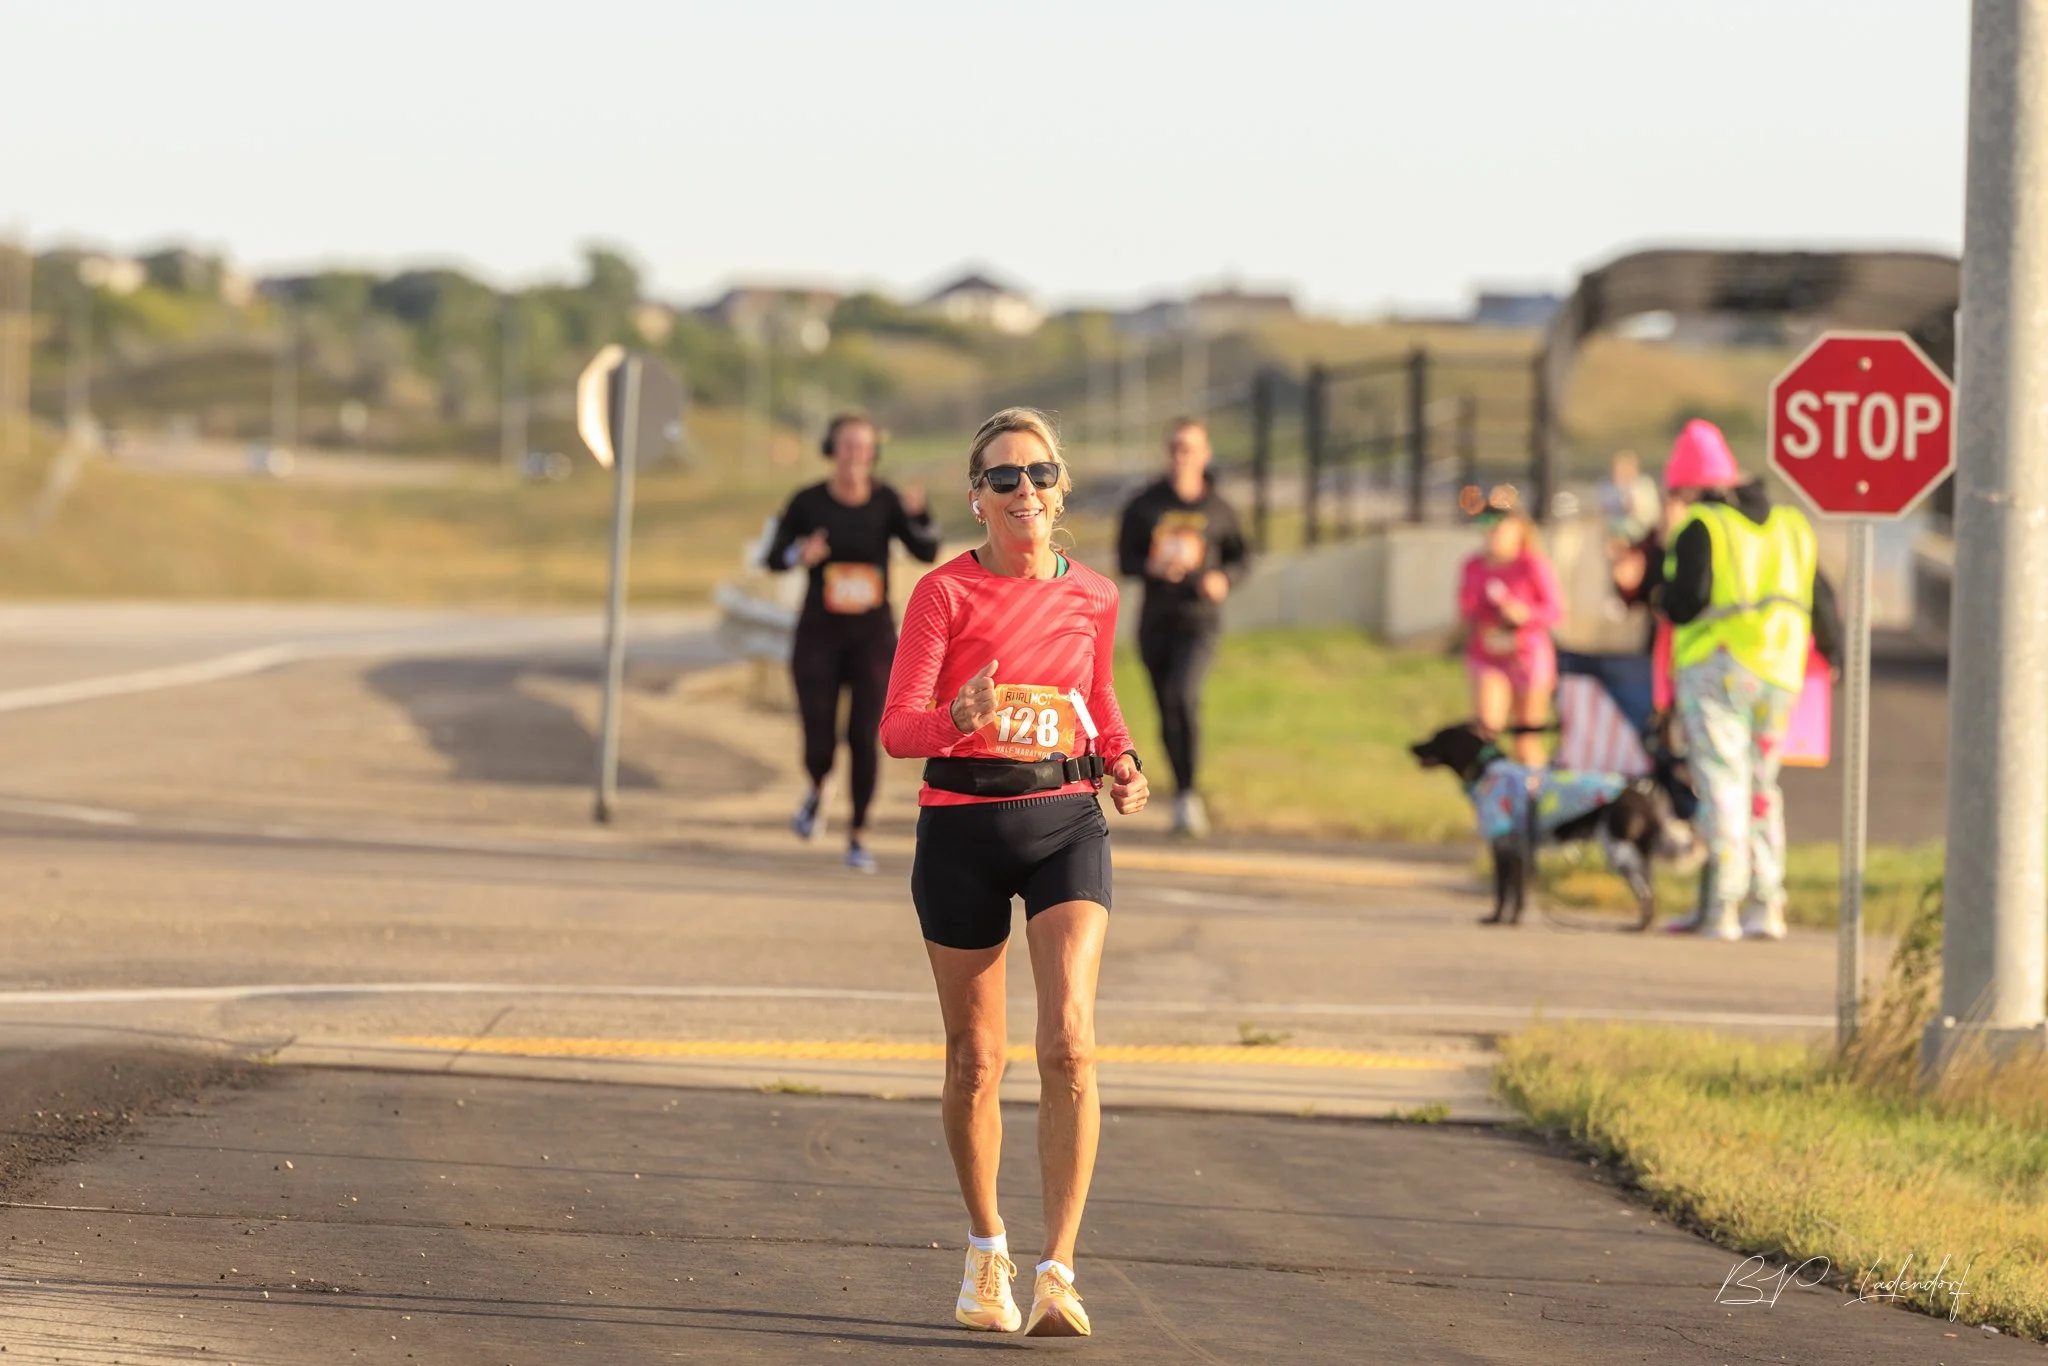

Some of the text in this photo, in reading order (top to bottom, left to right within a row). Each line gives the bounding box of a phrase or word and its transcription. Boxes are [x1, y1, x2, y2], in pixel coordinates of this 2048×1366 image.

[1782, 390, 1942, 461] STOP
[997, 706, 1059, 748] 128
[995, 745, 1013, 754] HALF
